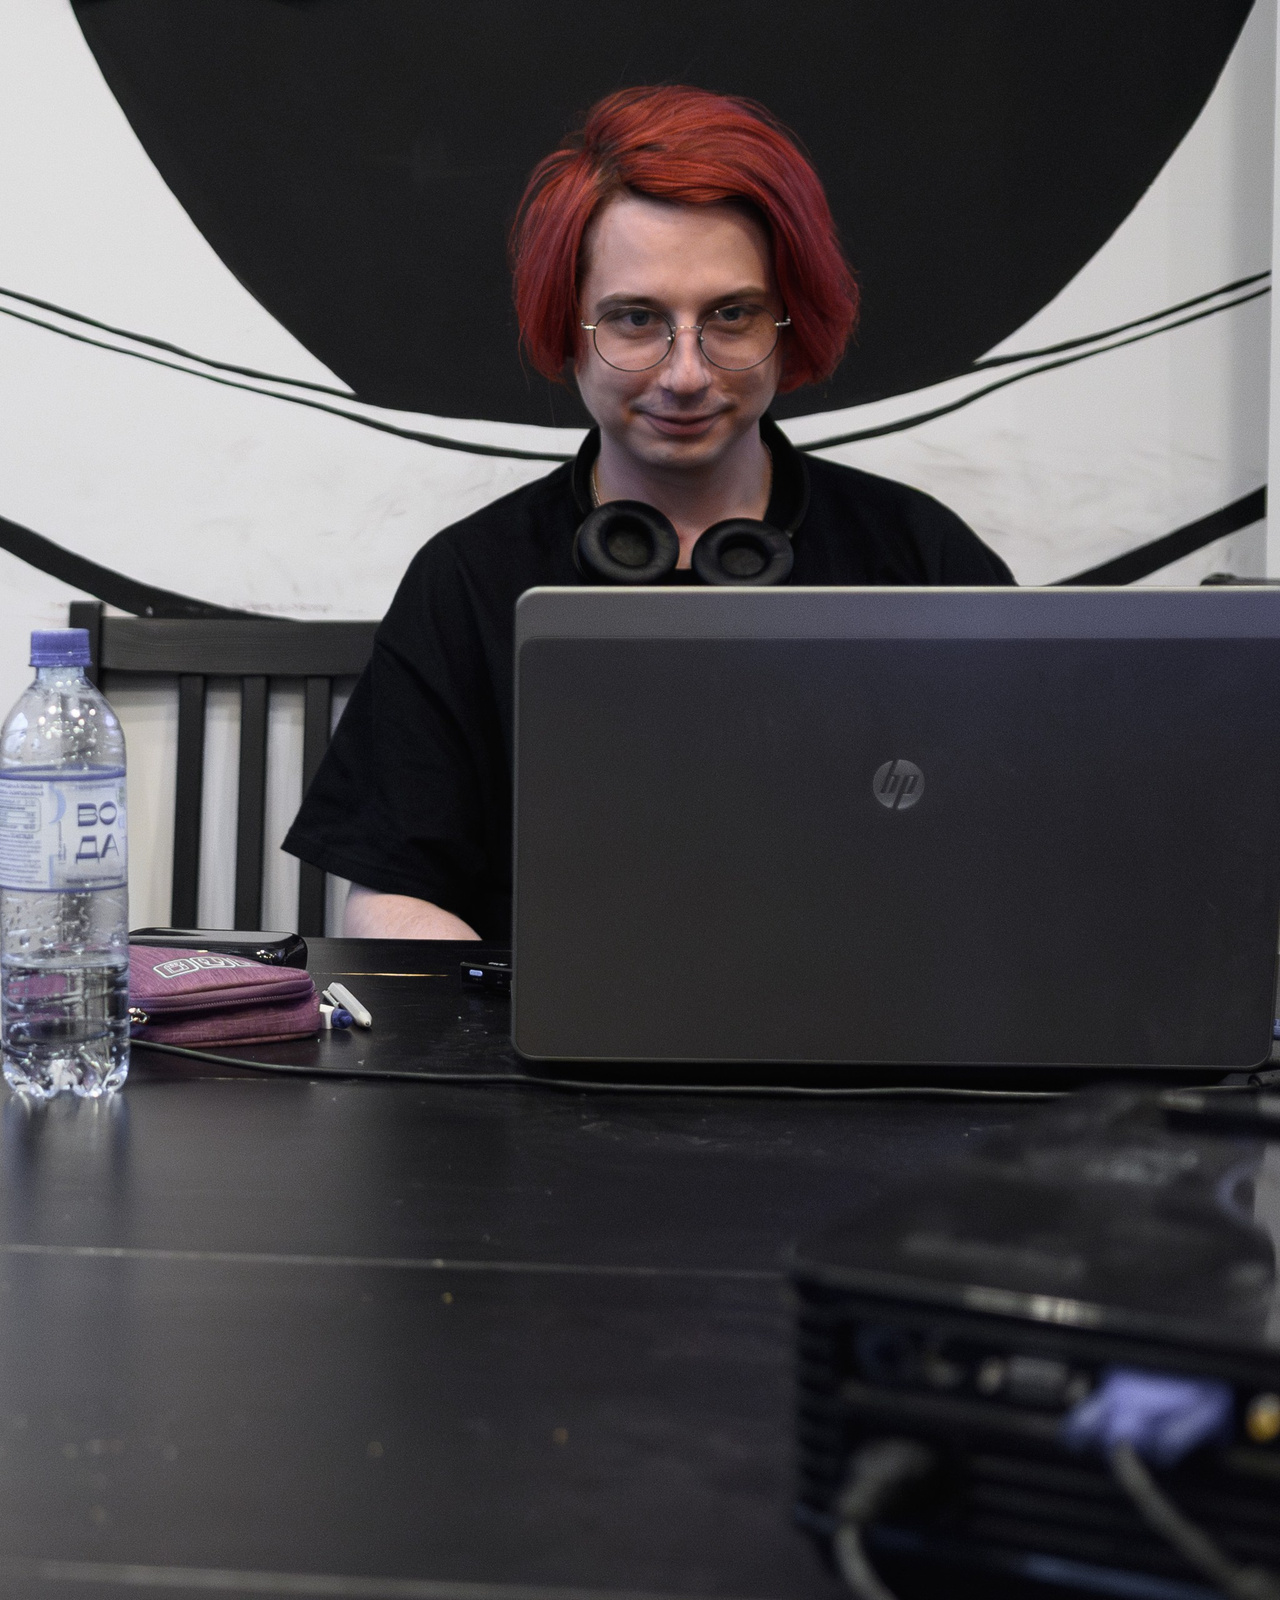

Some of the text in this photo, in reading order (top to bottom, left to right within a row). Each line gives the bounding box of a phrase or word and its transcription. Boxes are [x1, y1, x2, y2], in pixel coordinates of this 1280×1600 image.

[876, 759, 923, 810] hp
[77, 801, 117, 827] ВО
[75, 834, 119, 864] ДА
